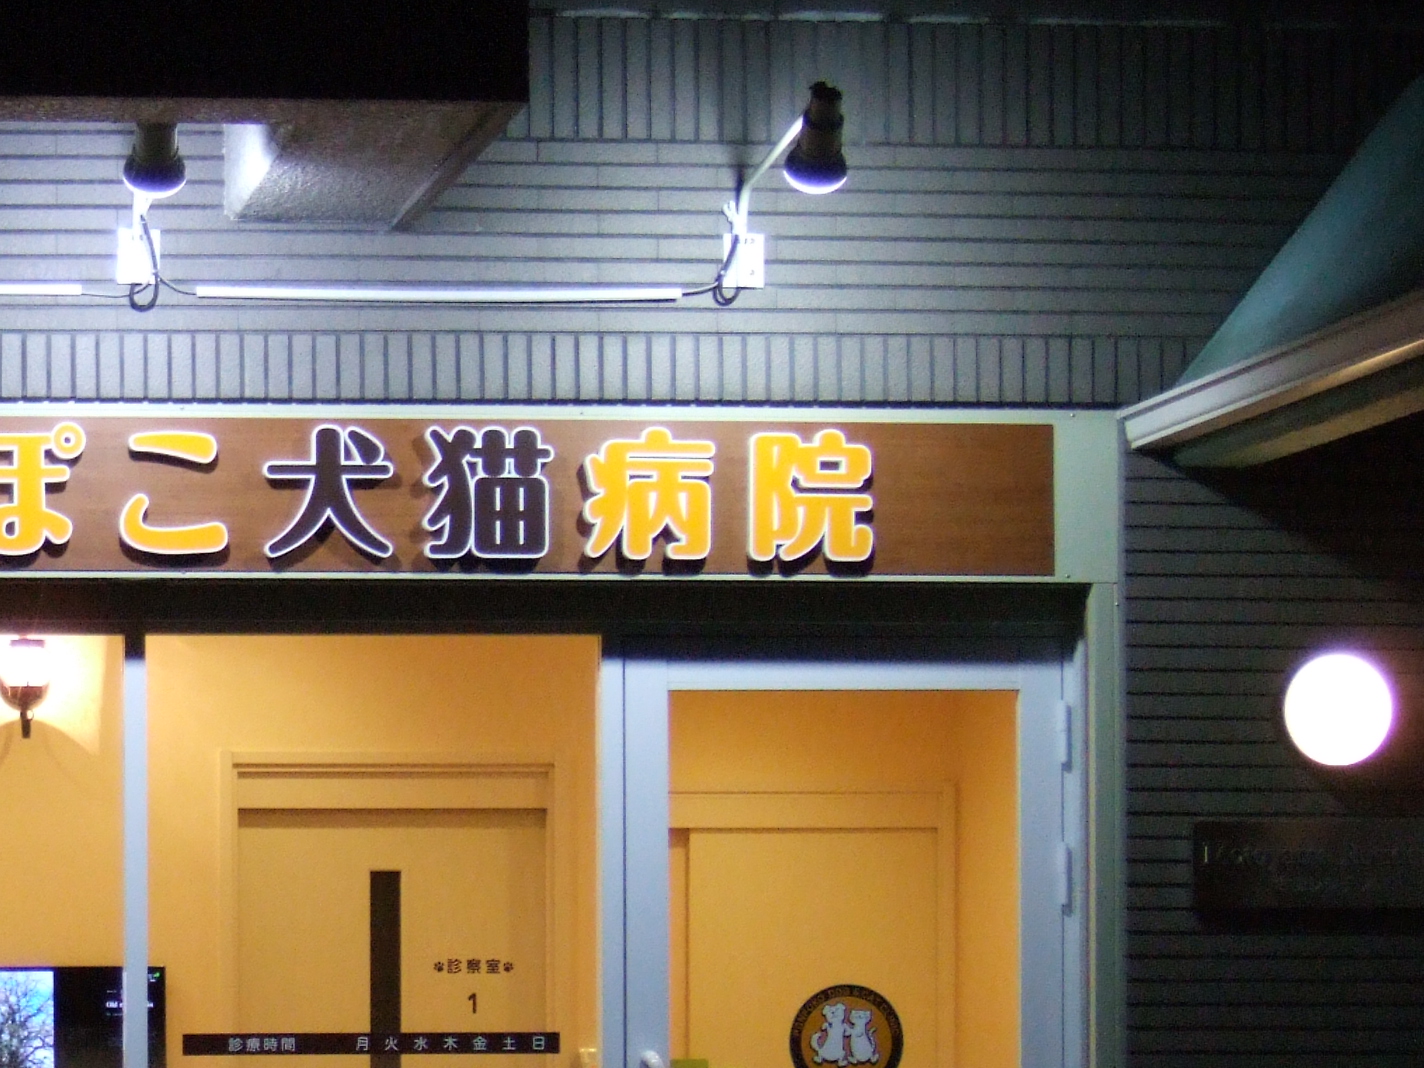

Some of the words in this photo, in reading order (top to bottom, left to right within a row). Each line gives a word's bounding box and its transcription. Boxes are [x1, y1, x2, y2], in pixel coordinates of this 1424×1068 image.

[446, 958, 502, 975] 診察室
[467, 992, 478, 1014] 1
[228, 1037, 296, 1053] 診療時間
[355, 1036, 370, 1052] 月
[384, 1036, 399, 1052] 火
[413, 1036, 428, 1052] 水
[443, 1036, 458, 1052] 木
[472, 1036, 487, 1052] 金
[501, 1036, 517, 1052] 土
[532, 1036, 546, 1052] 日
